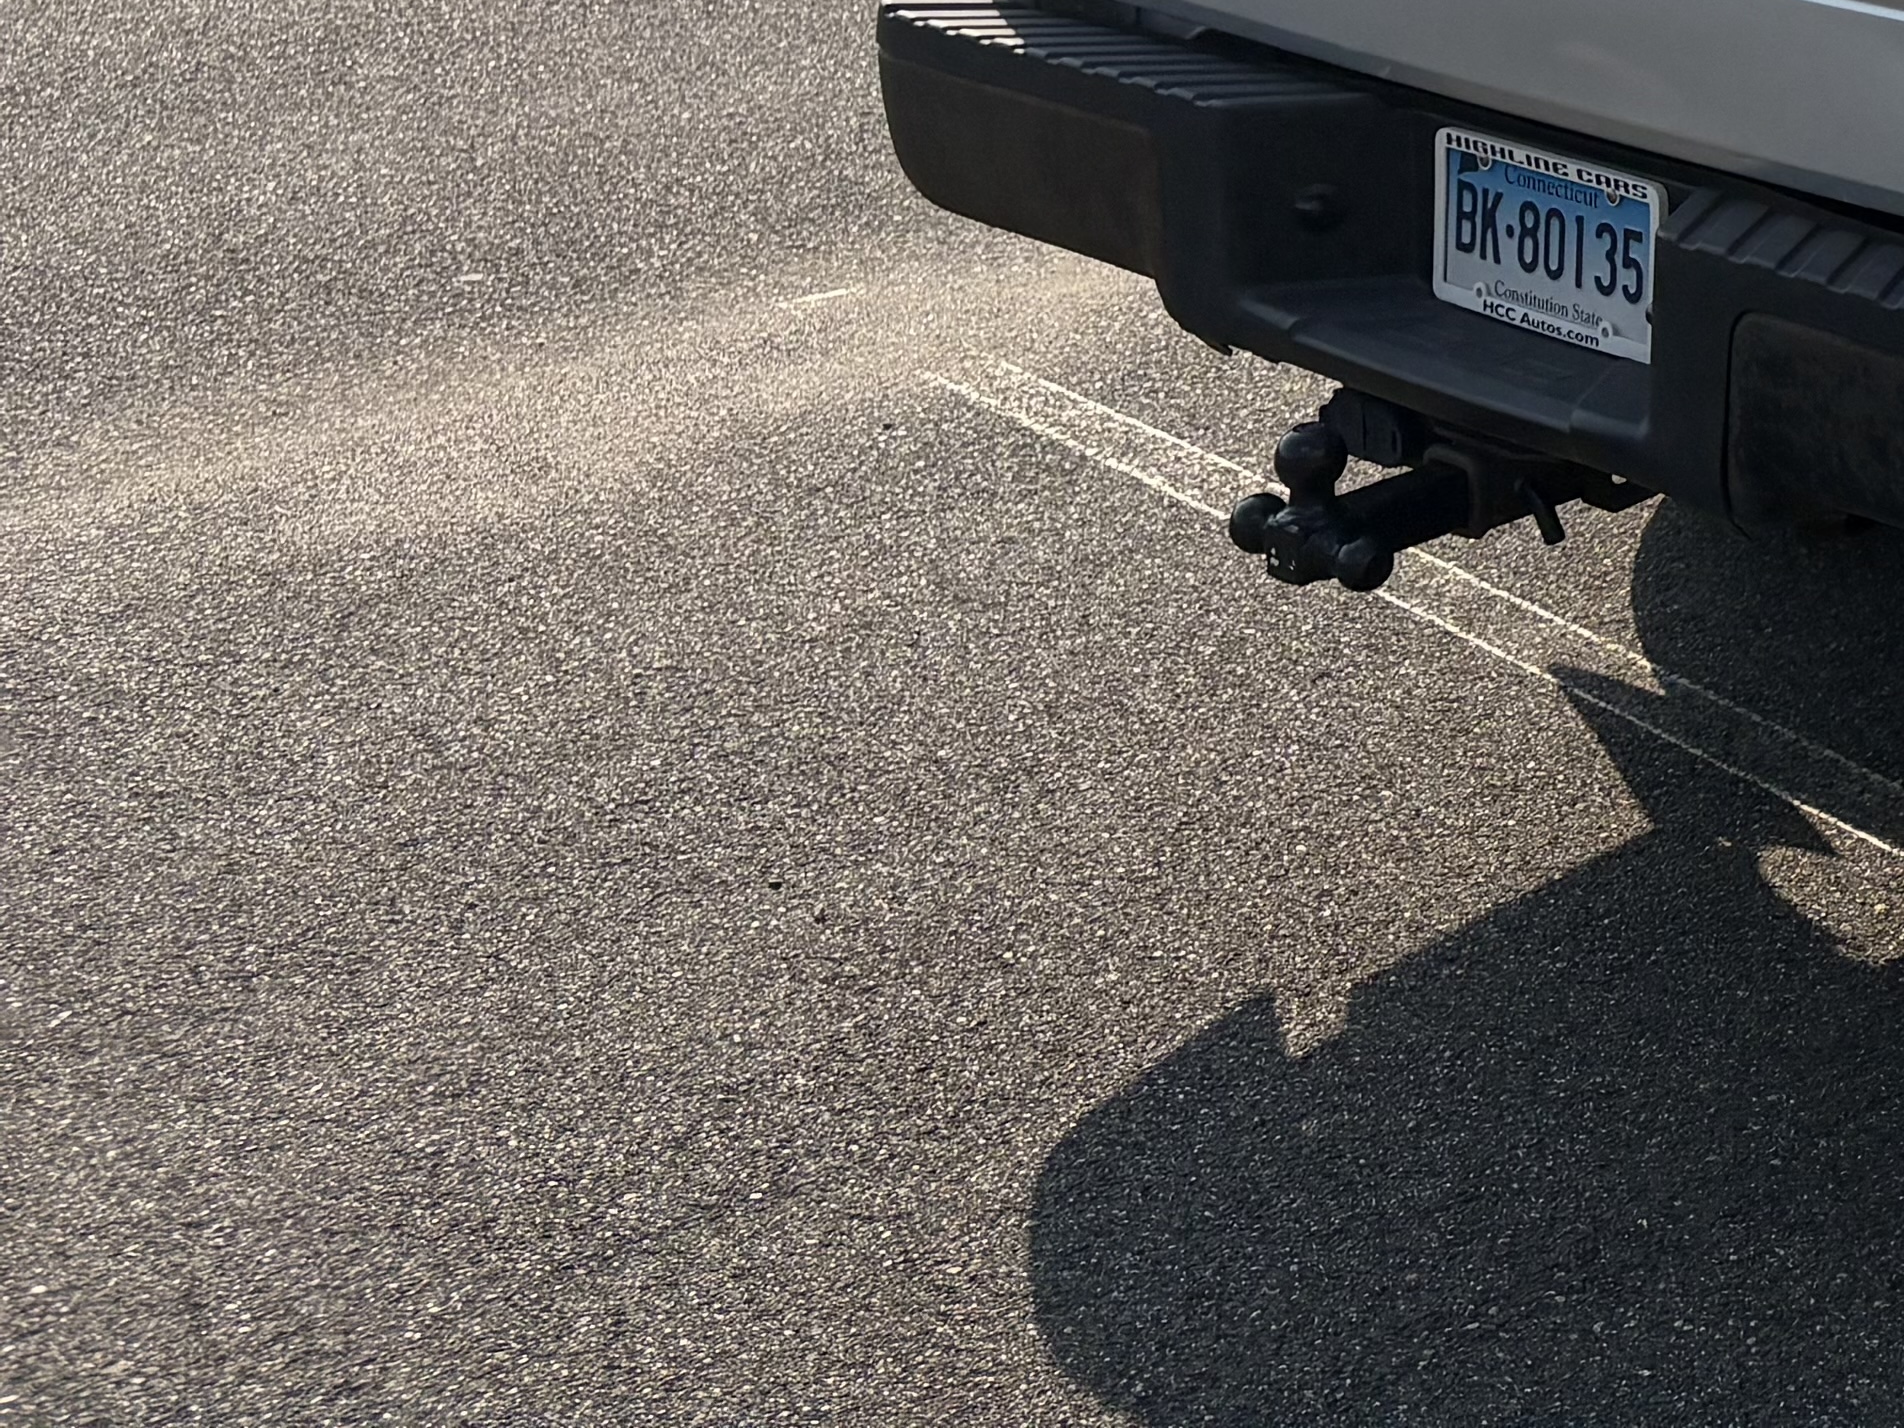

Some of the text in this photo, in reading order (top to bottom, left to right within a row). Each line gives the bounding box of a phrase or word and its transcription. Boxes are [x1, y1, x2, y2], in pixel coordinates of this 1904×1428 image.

[1446, 132, 1648, 200] HIGHLINE CARS
[1504, 165, 1599, 208] Connecticut
[1483, 299, 1600, 347] HCC Autos.com
[1494, 279, 1603, 327] Constitution State
